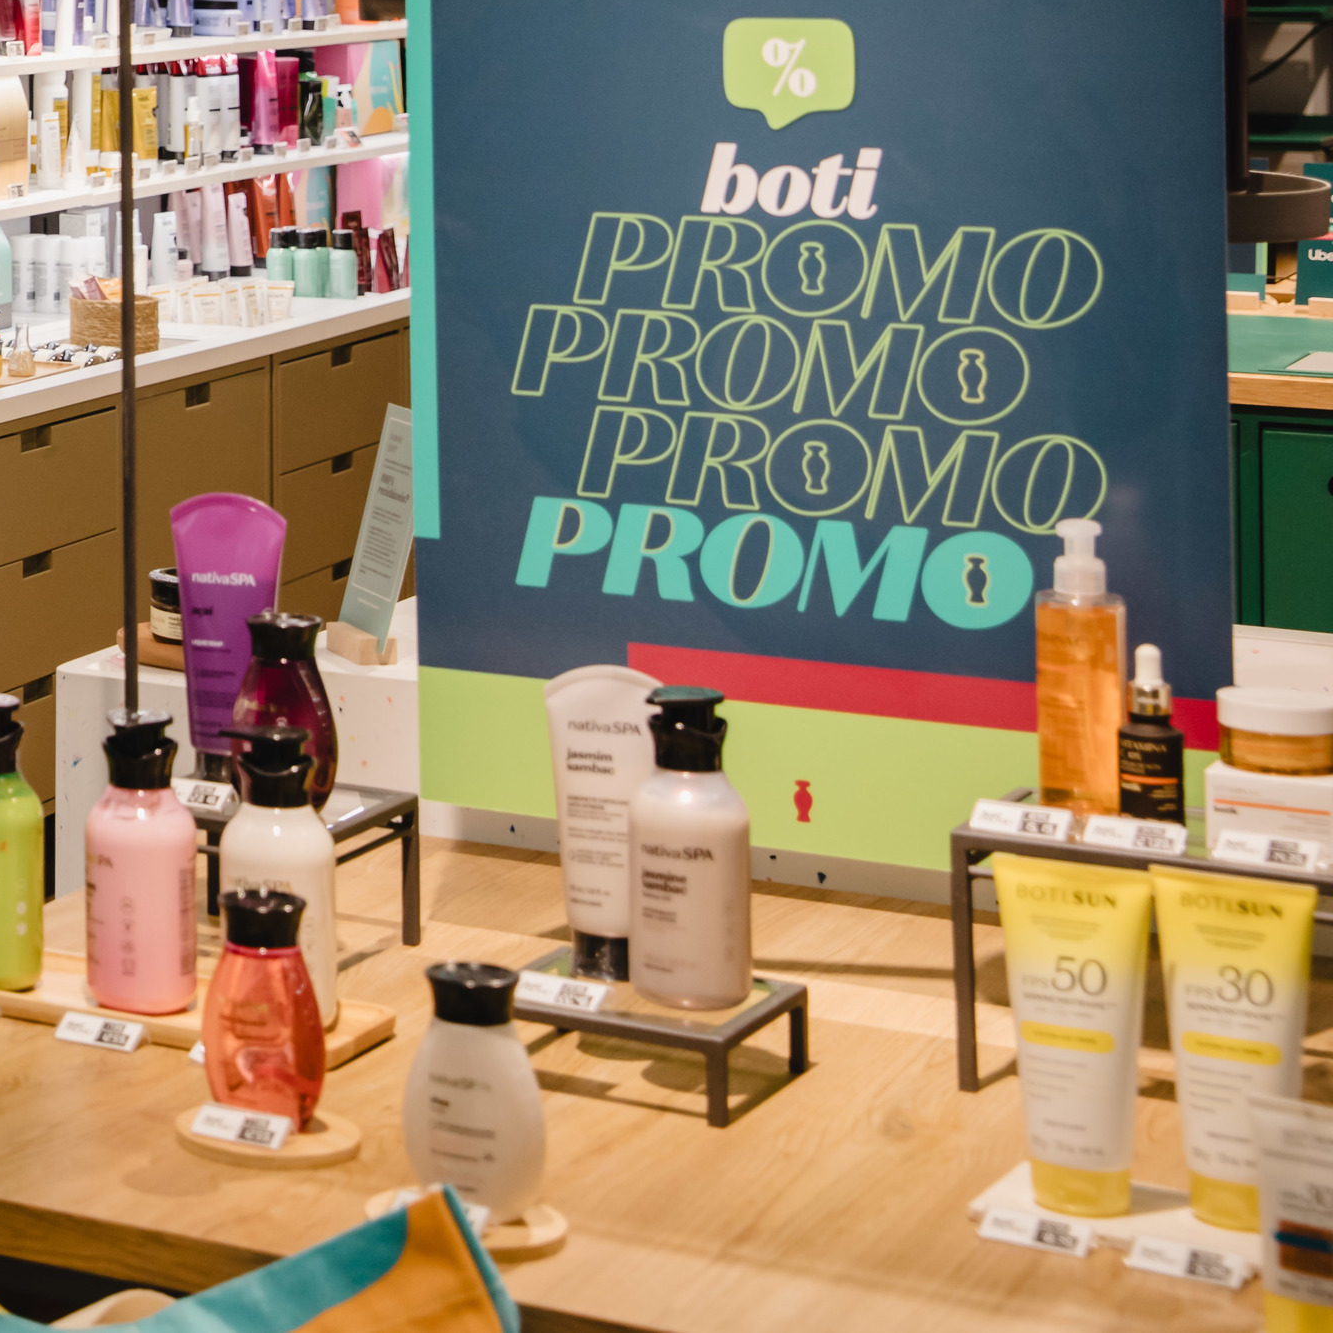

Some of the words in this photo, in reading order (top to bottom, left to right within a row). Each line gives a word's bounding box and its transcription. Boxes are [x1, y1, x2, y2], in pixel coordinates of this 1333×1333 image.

[700, 141, 883, 222] boti
[572, 211, 1104, 330] PROMO
[511, 303, 1030, 425] PROMO
[576, 405, 1108, 535] PROMO
[191, 571, 256, 587] nativaSPA
[515, 495, 1035, 631] PROMO
[568, 719, 642, 737] nativaSPA
[641, 843, 713, 861] nativaSPA
[1051, 955, 1107, 996] 50
[1217, 965, 1274, 1007] 30
